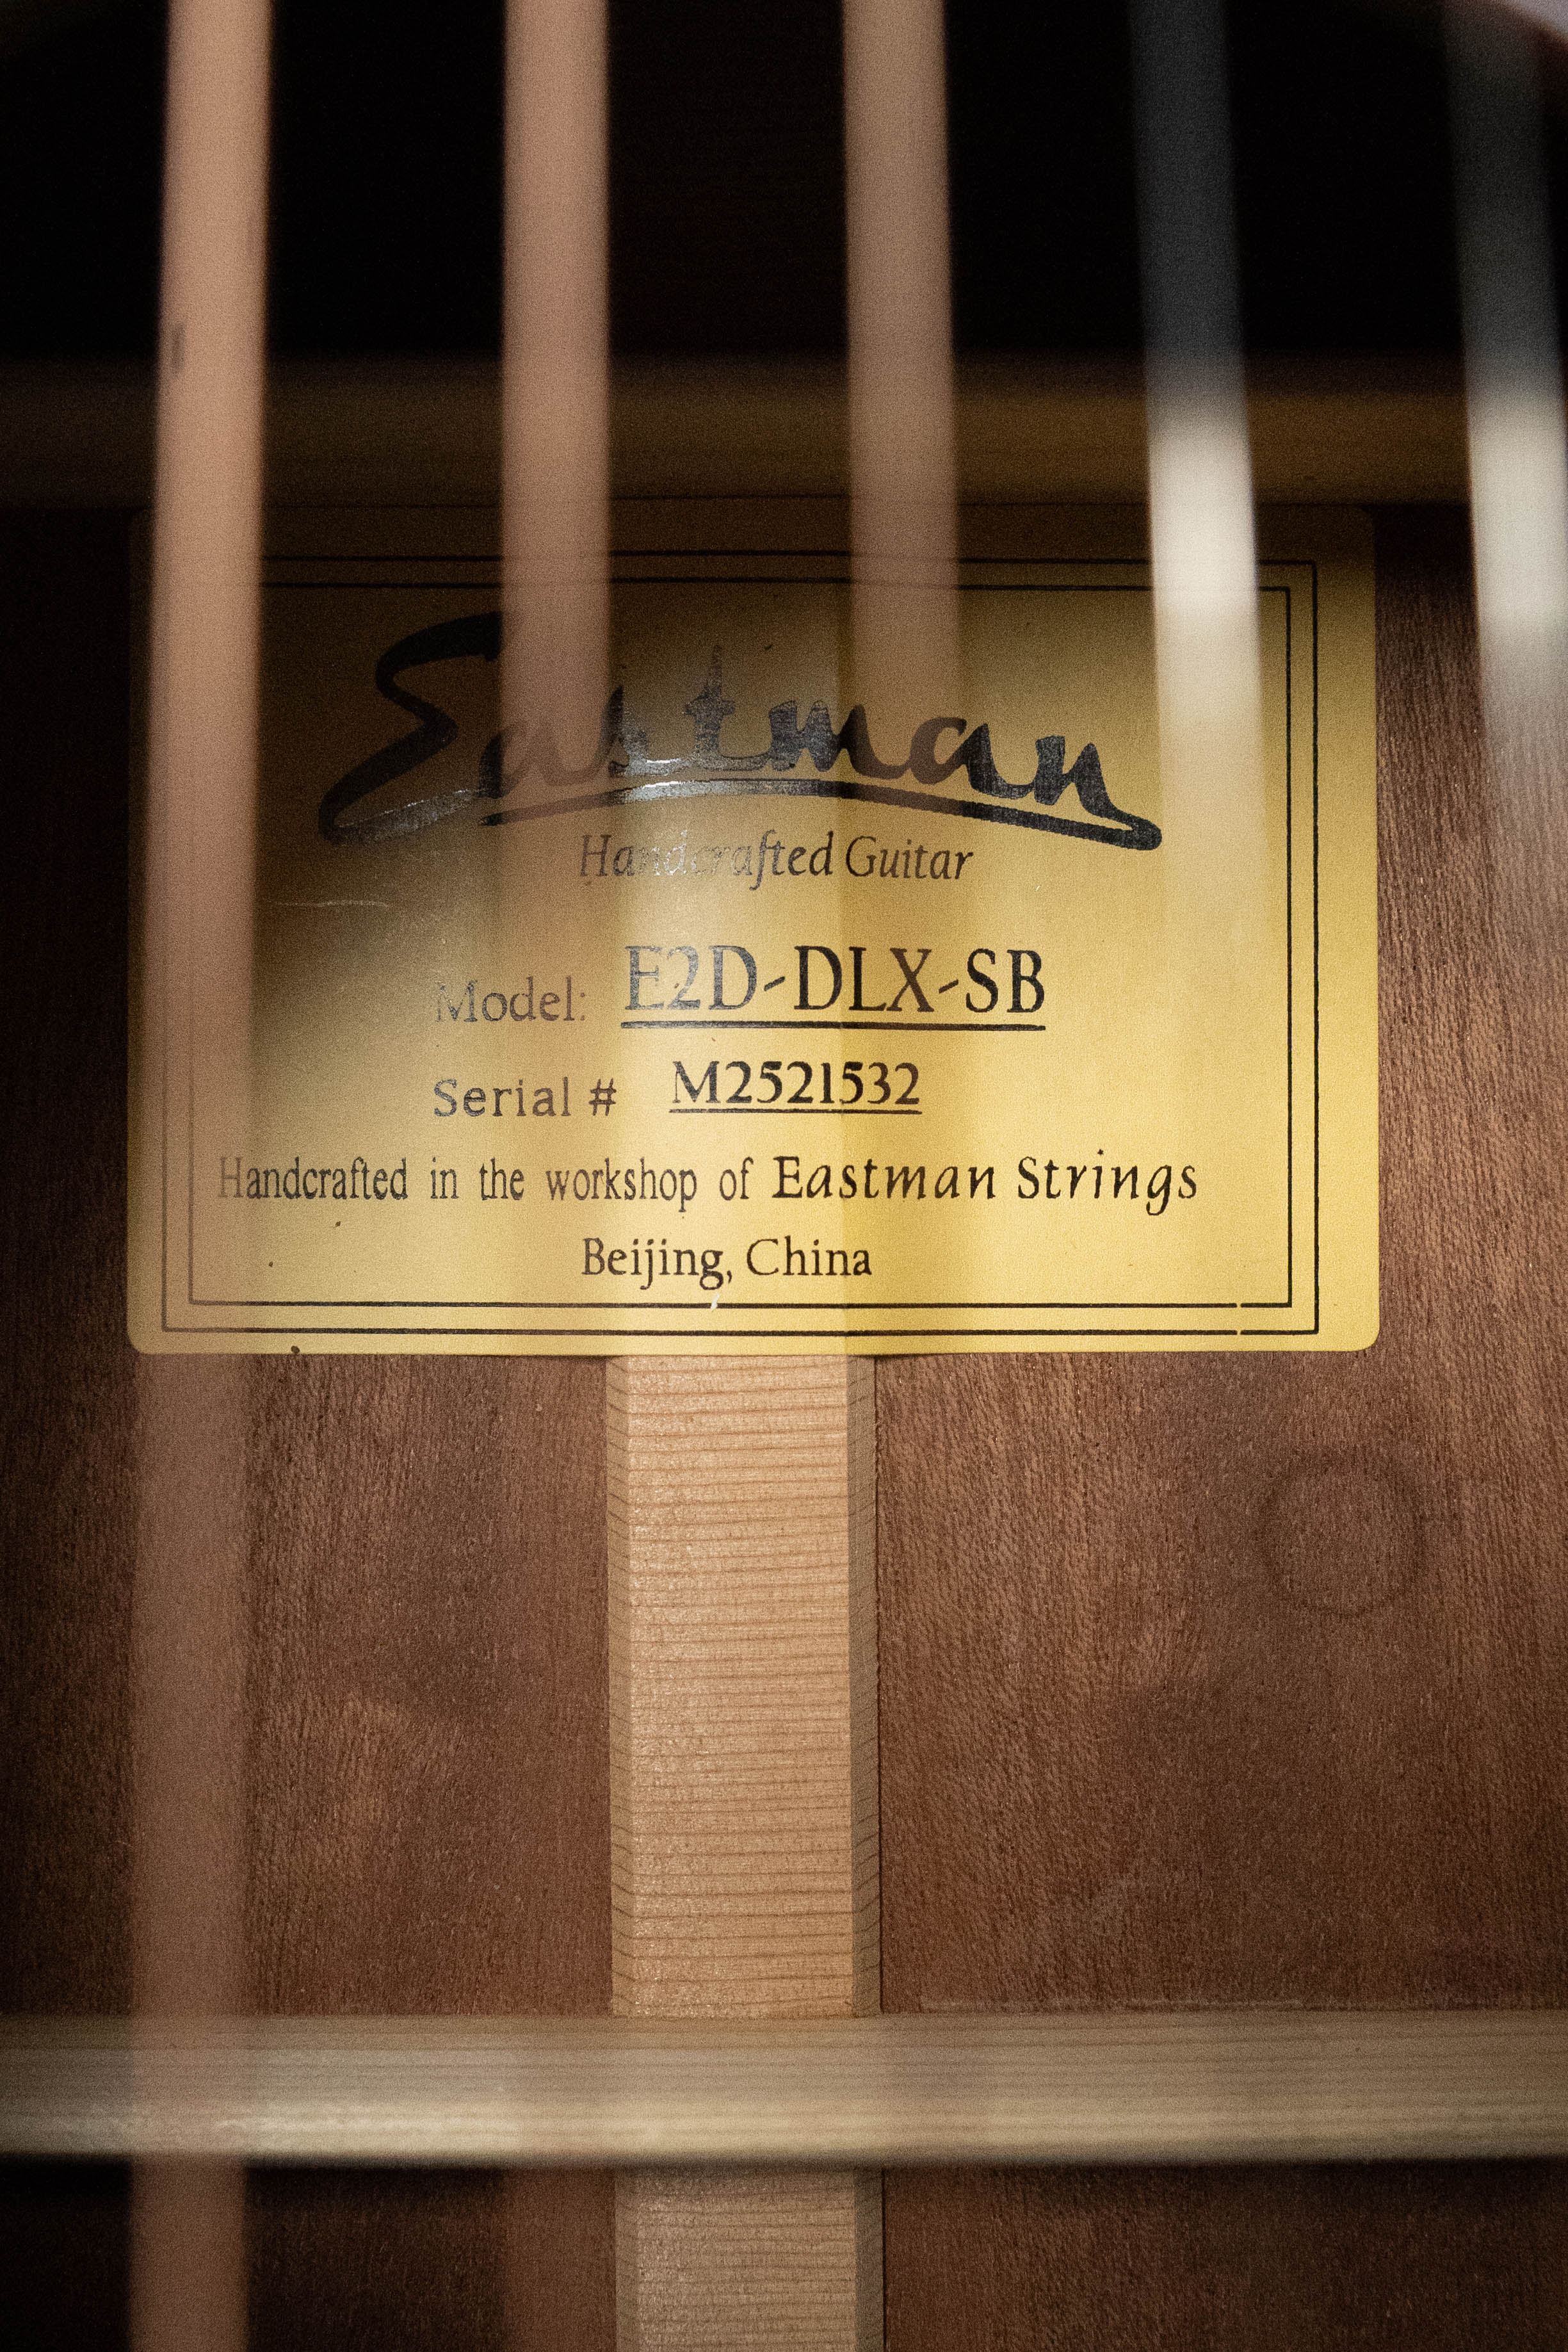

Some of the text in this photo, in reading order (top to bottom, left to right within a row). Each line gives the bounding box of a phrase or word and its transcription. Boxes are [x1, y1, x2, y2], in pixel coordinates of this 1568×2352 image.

[579, 829, 974, 891] Handcrafted Guitar
[433, 945, 1046, 1023] Model: E2D-DLX-SB
[433, 1060, 921, 1117] Serial # M2521532
[218, 1149, 1198, 1216] Handcrafted in the workshop of Eastman Strings
[581, 1236, 873, 1291] Beijing, China
